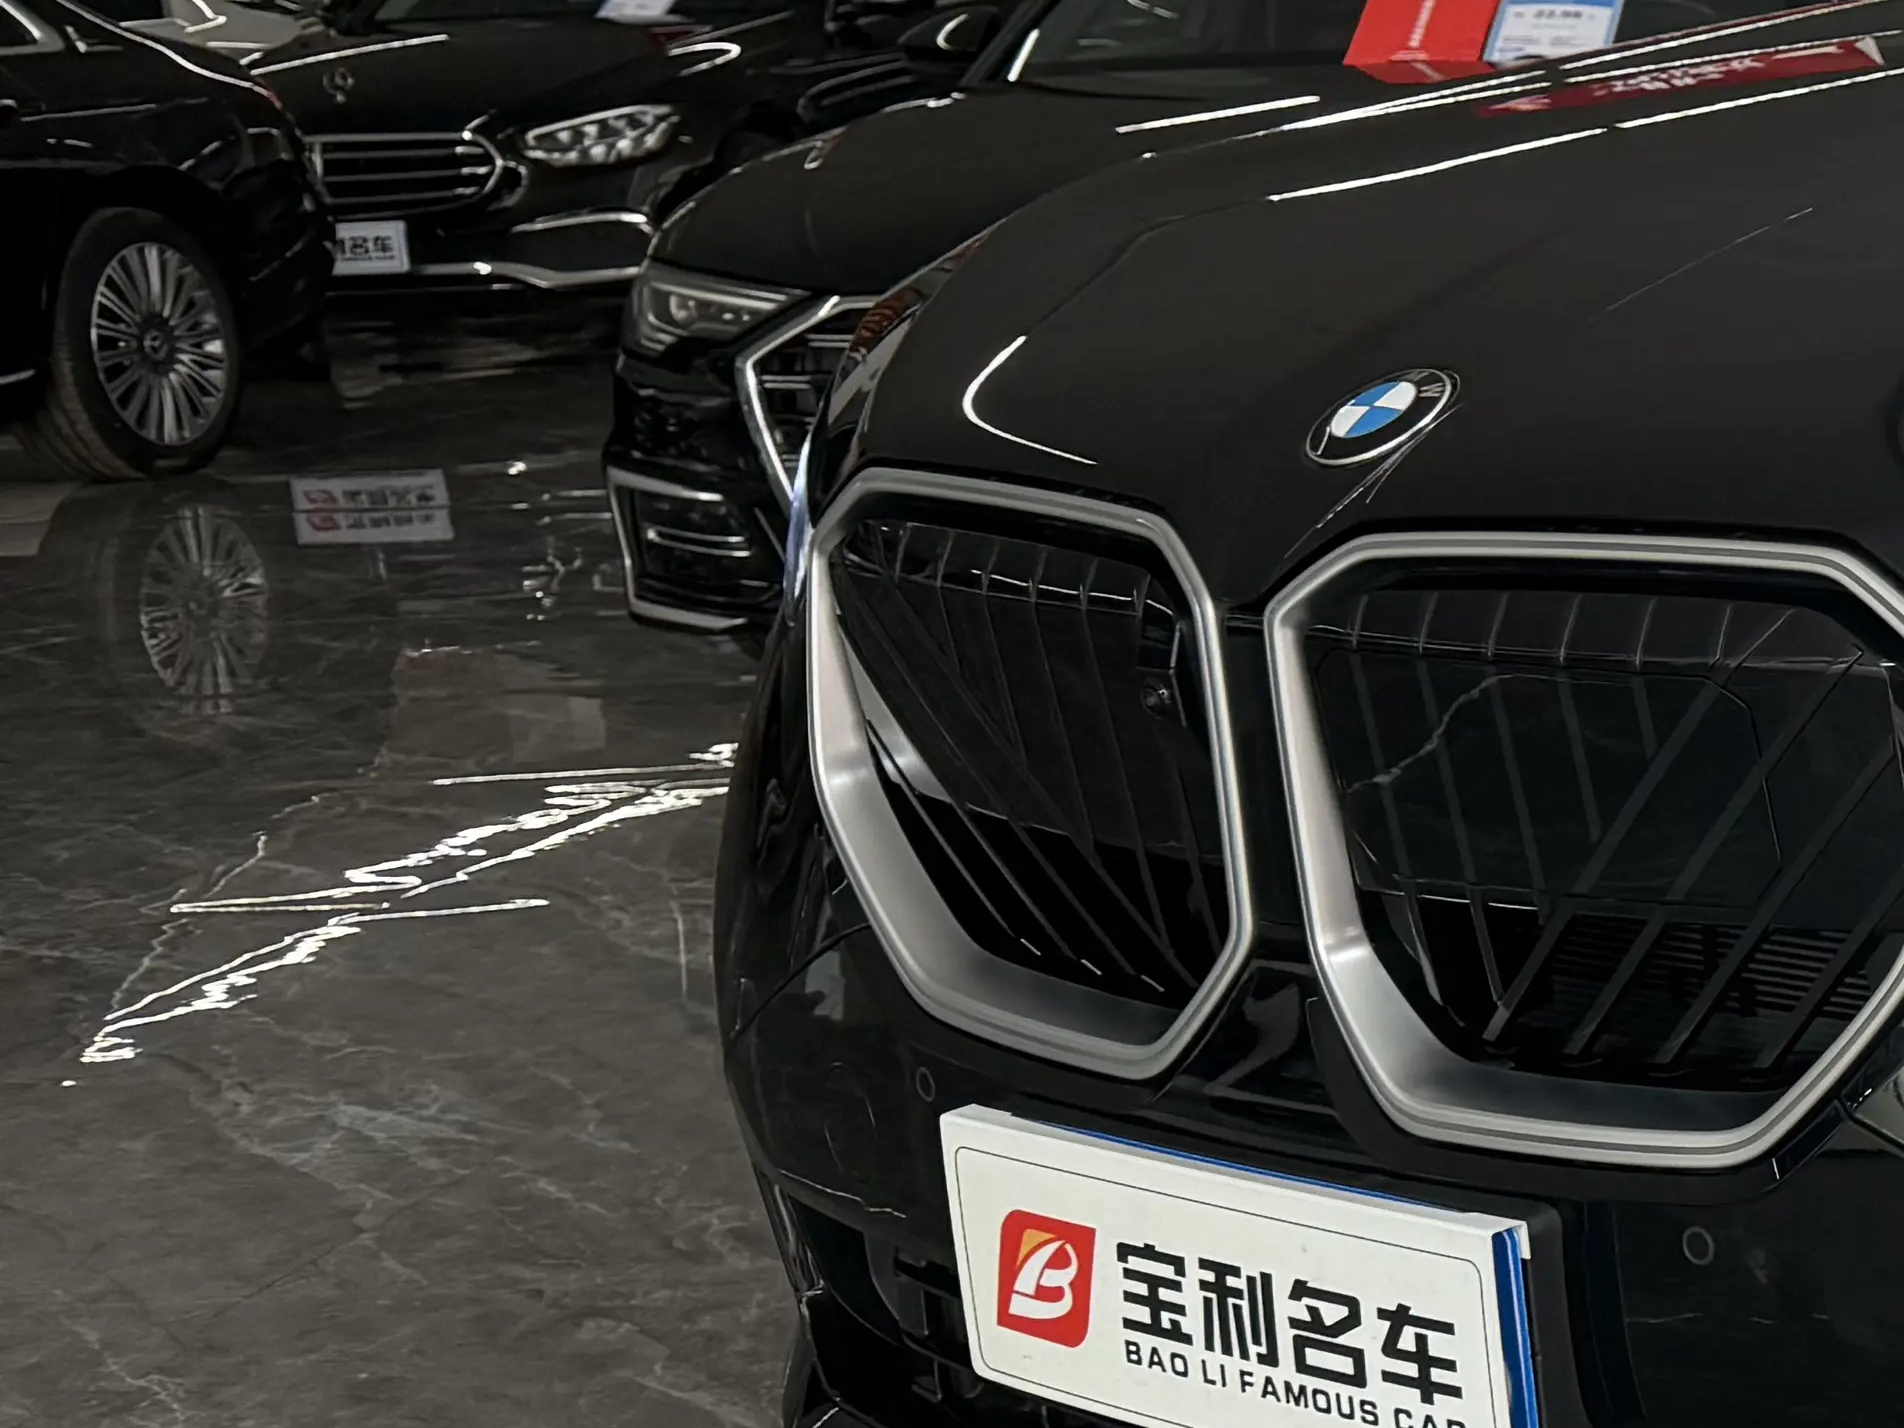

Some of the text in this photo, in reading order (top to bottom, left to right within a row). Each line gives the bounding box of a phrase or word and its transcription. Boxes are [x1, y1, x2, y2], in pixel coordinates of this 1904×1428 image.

[1116, 1242, 1463, 1406] 宝利名车
[1124, 1339, 1189, 1378] BAO
[1201, 1358, 1227, 1388] LI
[1239, 1369, 1379, 1426] FAMOUS
